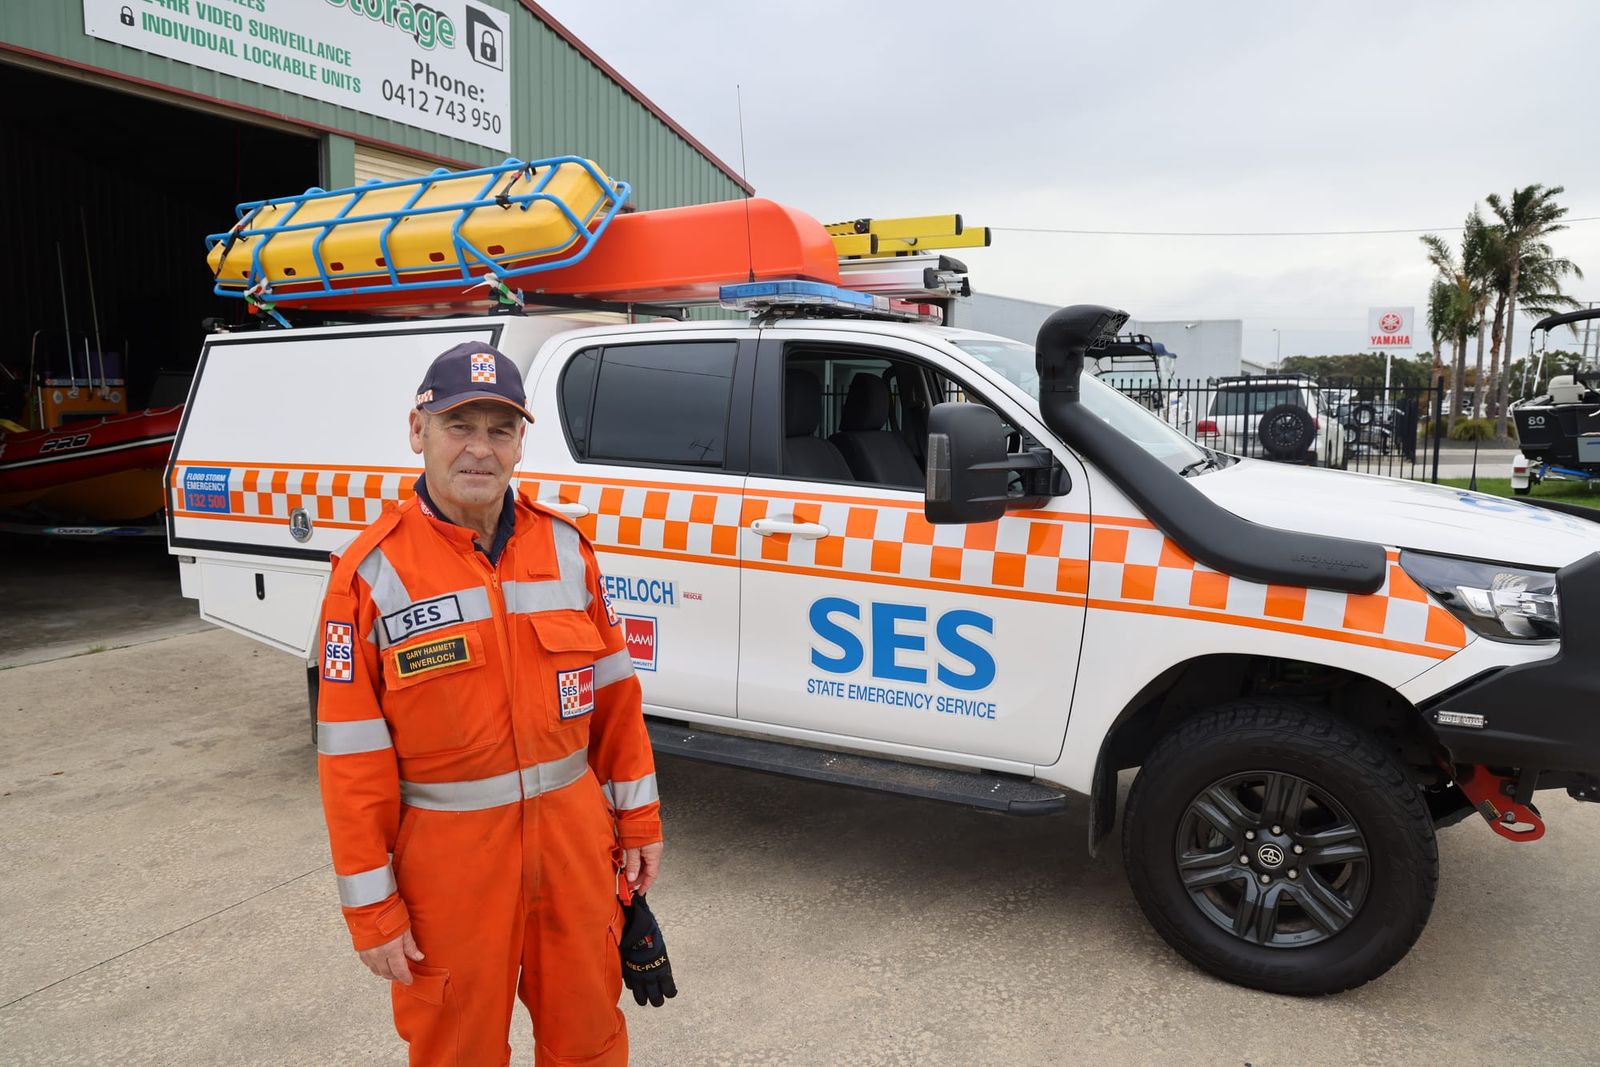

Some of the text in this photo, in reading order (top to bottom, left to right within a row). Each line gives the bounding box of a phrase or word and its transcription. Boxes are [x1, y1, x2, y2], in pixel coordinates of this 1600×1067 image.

[196, 1, 243, 32] VIDEO
[249, 19, 352, 67] SURVEILLANCE
[142, 11, 361, 93] INDIVIDUAL LOCKABLE UNITS
[411, 59, 484, 103] Phone:
[382, 79, 501, 134] 0412 743 950
[1371, 335, 1410, 345] YAMAHA
[472, 363, 495, 372] SES
[1528, 416, 1545, 425] 80
[39, 433, 91, 452] PRO
[186, 473, 205, 481] FLOOD
[187, 481, 226, 491] EMERGENCY
[188, 494, 226, 508] 132 500
[403, 605, 441, 630] SES
[626, 633, 653, 646] AAMI
[809, 597, 996, 691] SES
[326, 644, 350, 660] SES
[406, 642, 456, 660] GARY HAMMETT
[409, 652, 456, 669] INVERLOCH
[561, 686, 578, 697] SES
[807, 679, 996, 719] STATE EMERGENCY SERVICE
